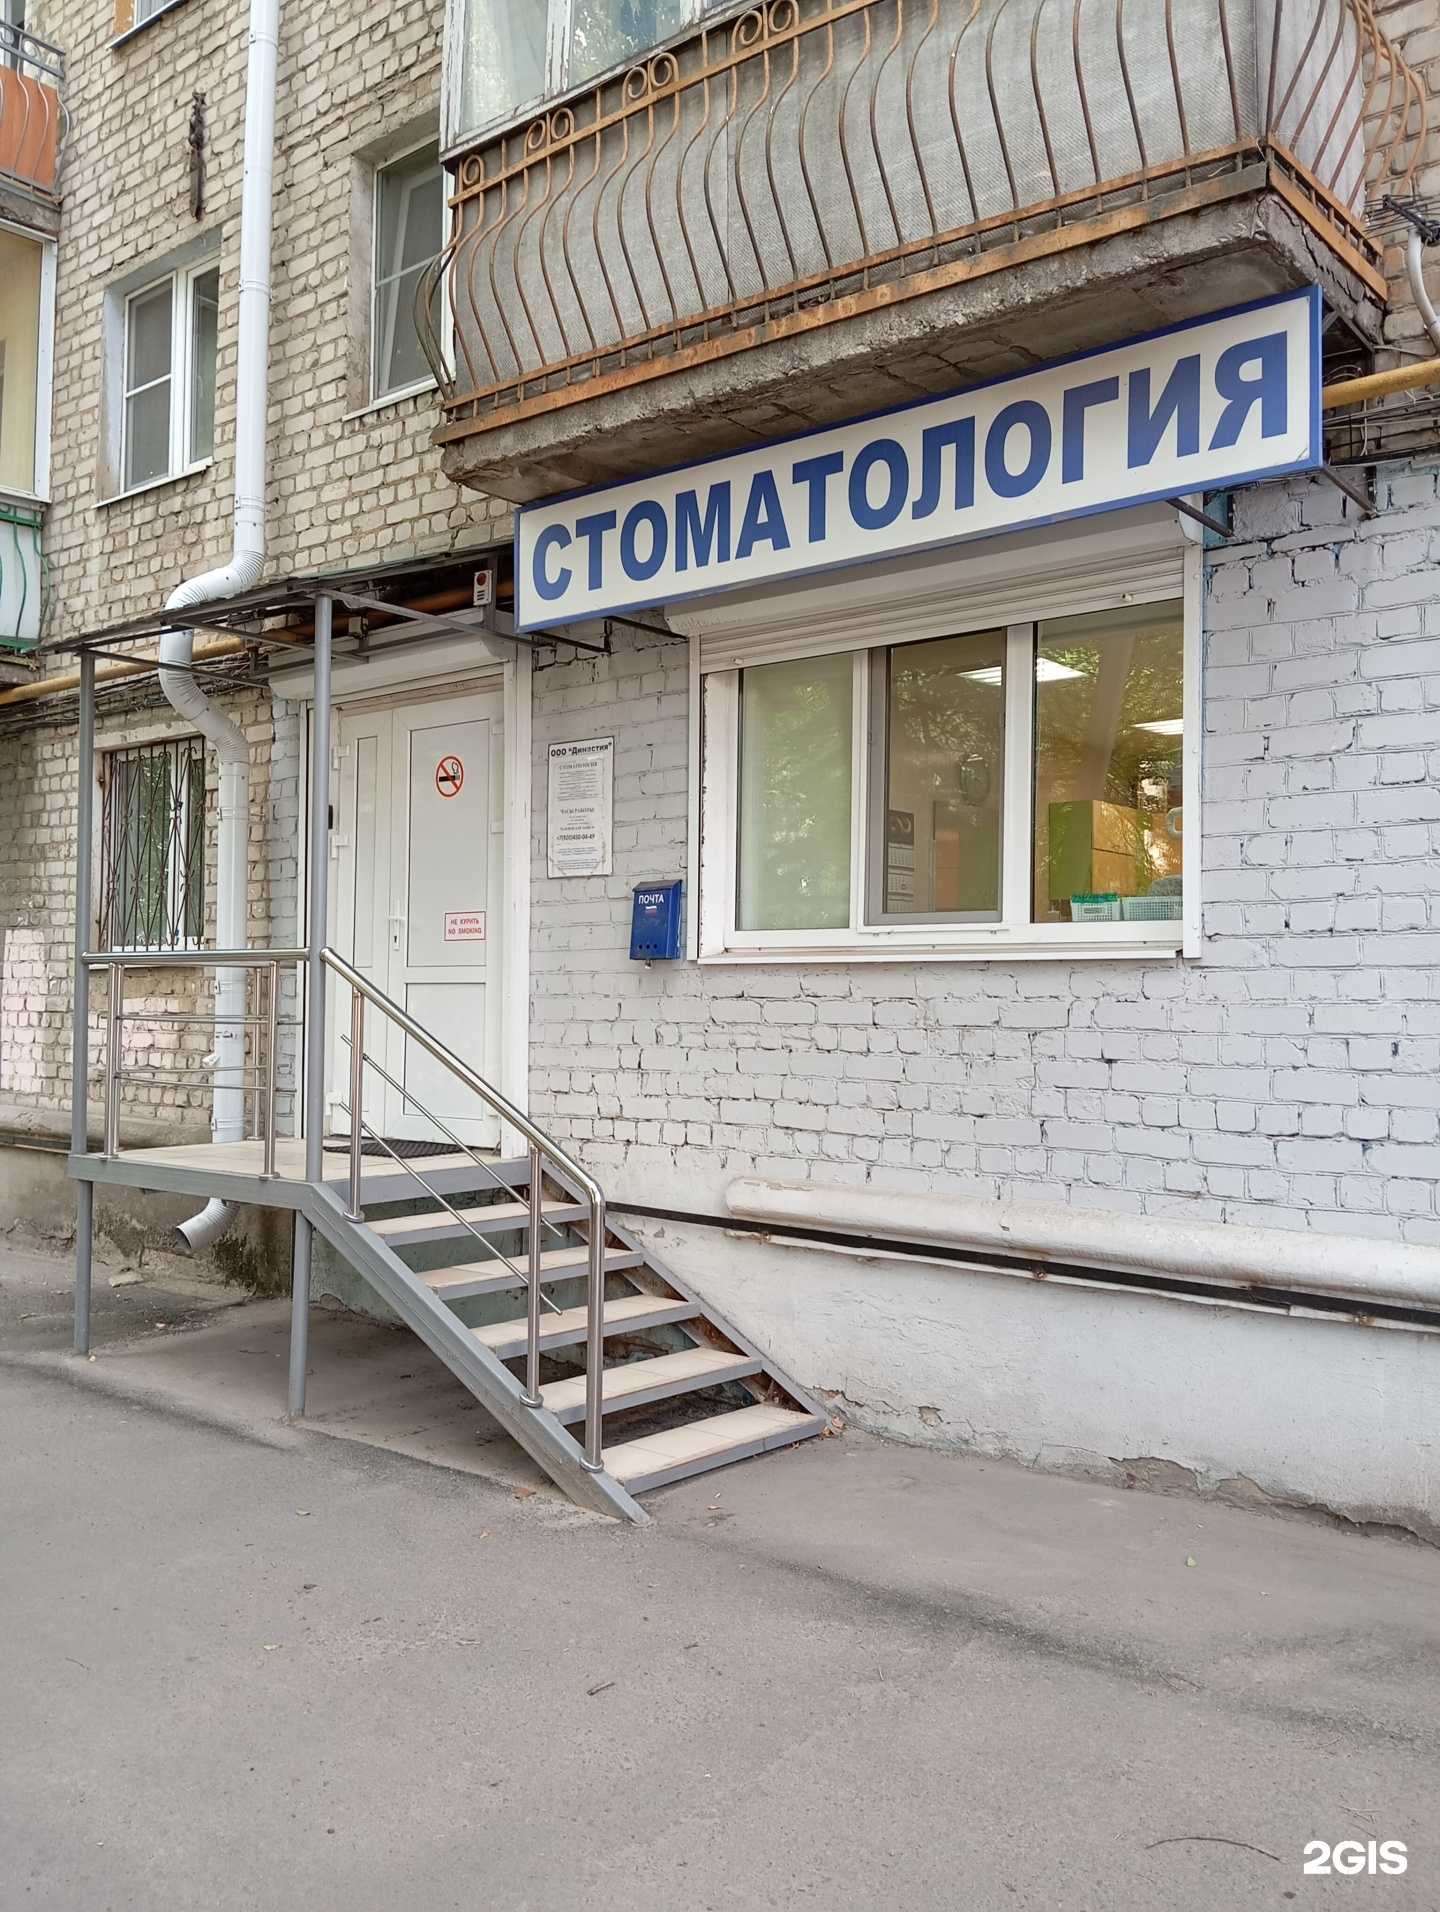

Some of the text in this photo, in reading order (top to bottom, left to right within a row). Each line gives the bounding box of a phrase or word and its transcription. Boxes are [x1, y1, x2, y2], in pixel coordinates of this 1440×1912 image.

[531, 330, 1288, 601] СТОМАТОЛОГИЯ
[551, 748, 567, 757] ООО
[638, 894, 664, 904] ПОЧТА
[450, 917, 480, 926] НЕ КУРИТЬ
[447, 926, 482, 935] NO SMOKING
